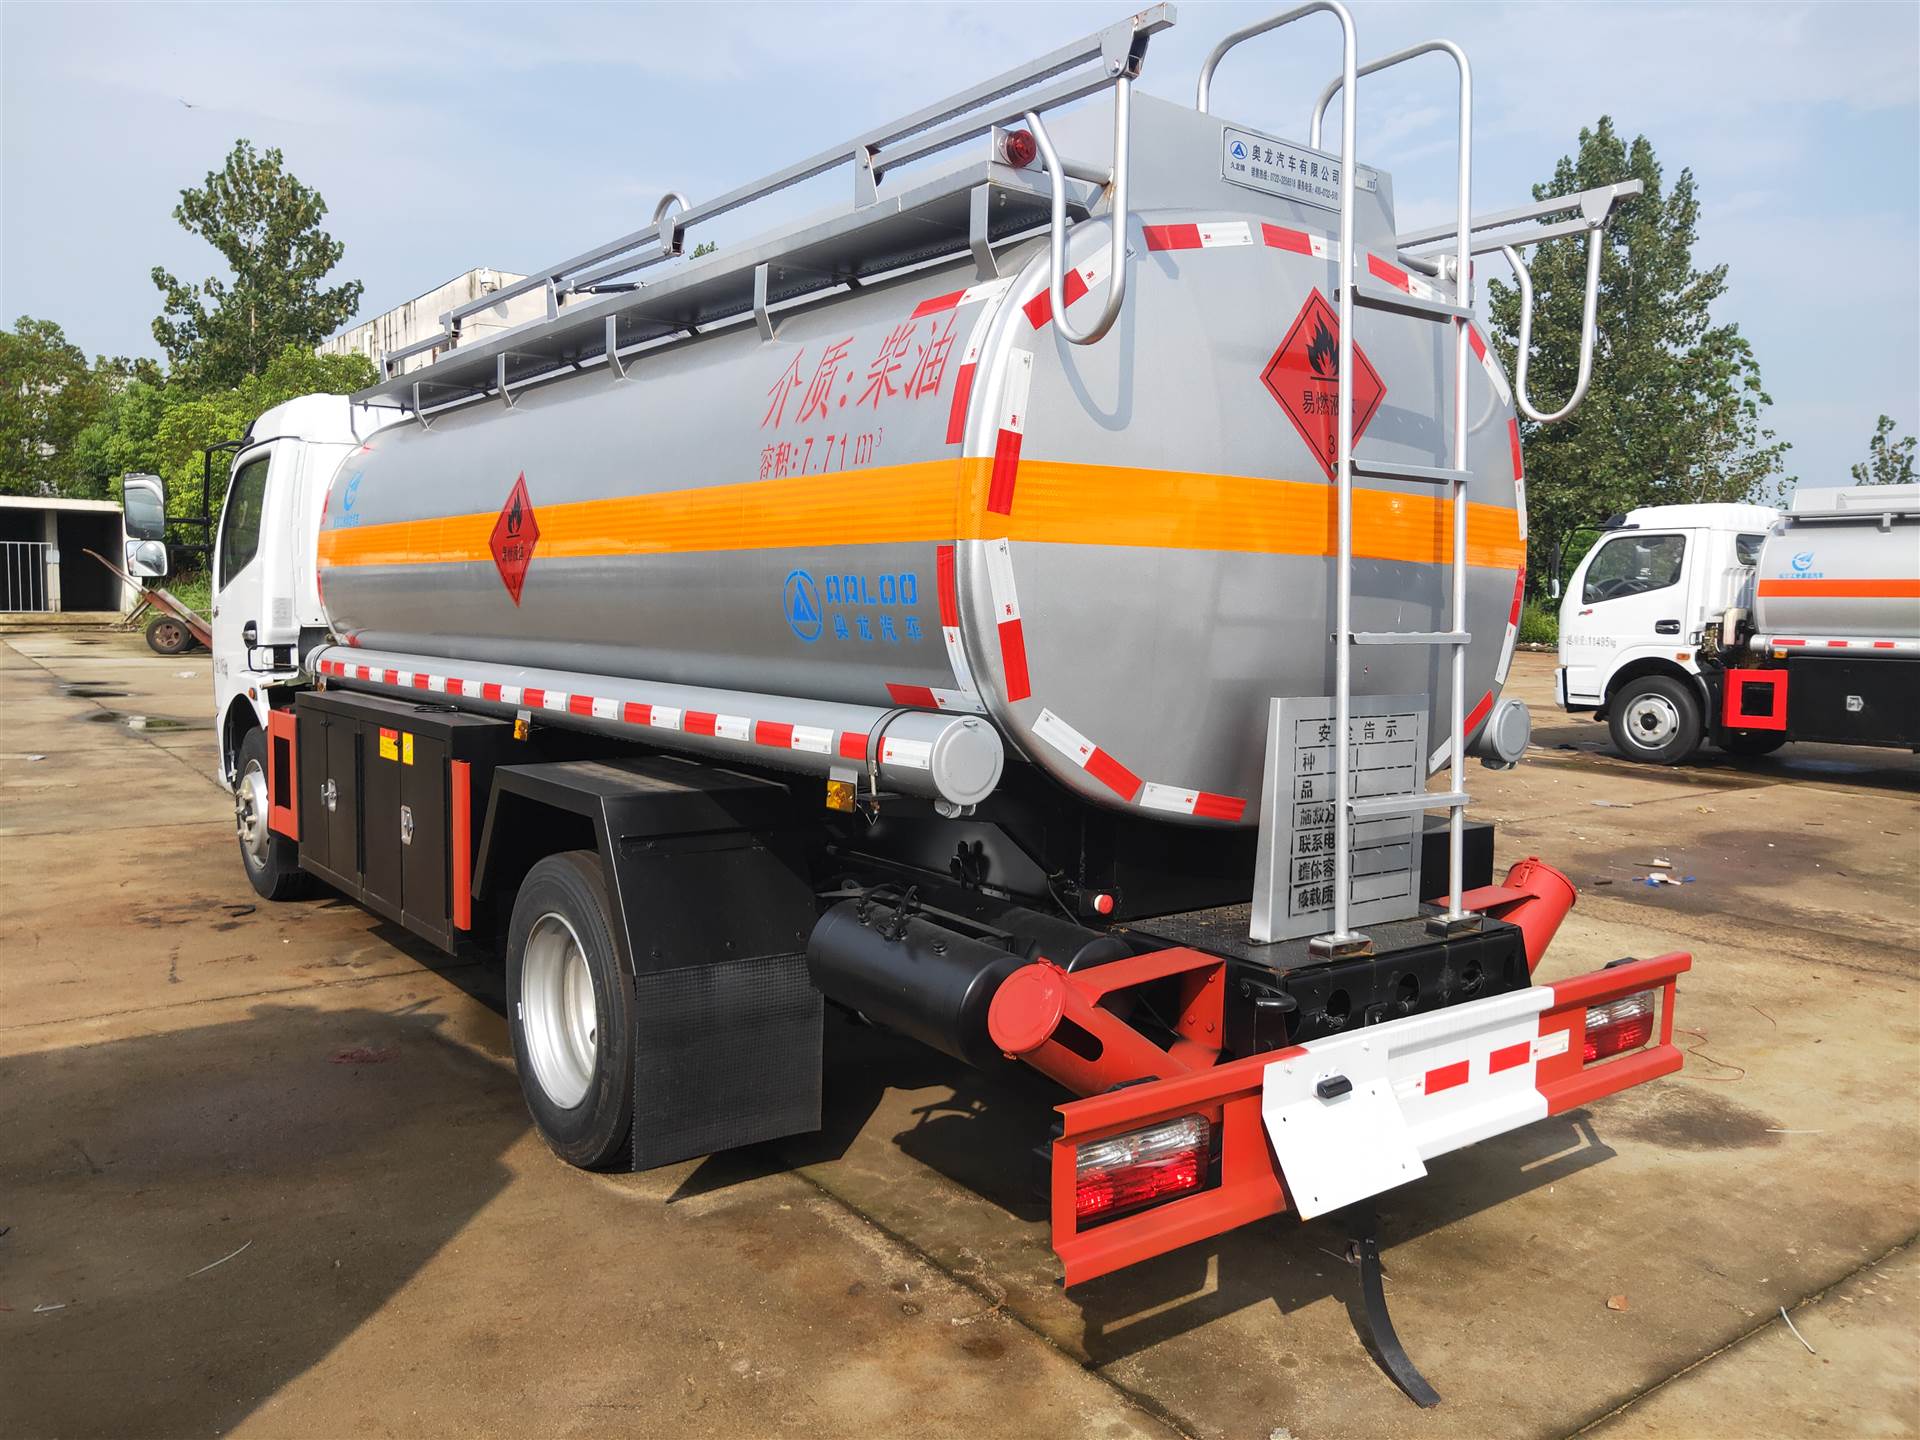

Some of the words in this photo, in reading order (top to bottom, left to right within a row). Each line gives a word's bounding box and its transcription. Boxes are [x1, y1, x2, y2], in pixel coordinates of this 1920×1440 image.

[1252, 144, 1340, 185] 奥龙汽车有限公司
[760, 311, 958, 430] 介质:柴油
[1303, 390, 1355, 415] 易燃液
[1328, 434, 1336, 455] 3
[833, 613, 923, 641] 奥龙汽车
[1318, 719, 1397, 742] 安告示
[1300, 806, 1336, 825] 施救方
[1299, 832, 1336, 853] 联系电
[1298, 857, 1335, 881] 罐体容
[1298, 884, 1335, 909] 核载质
